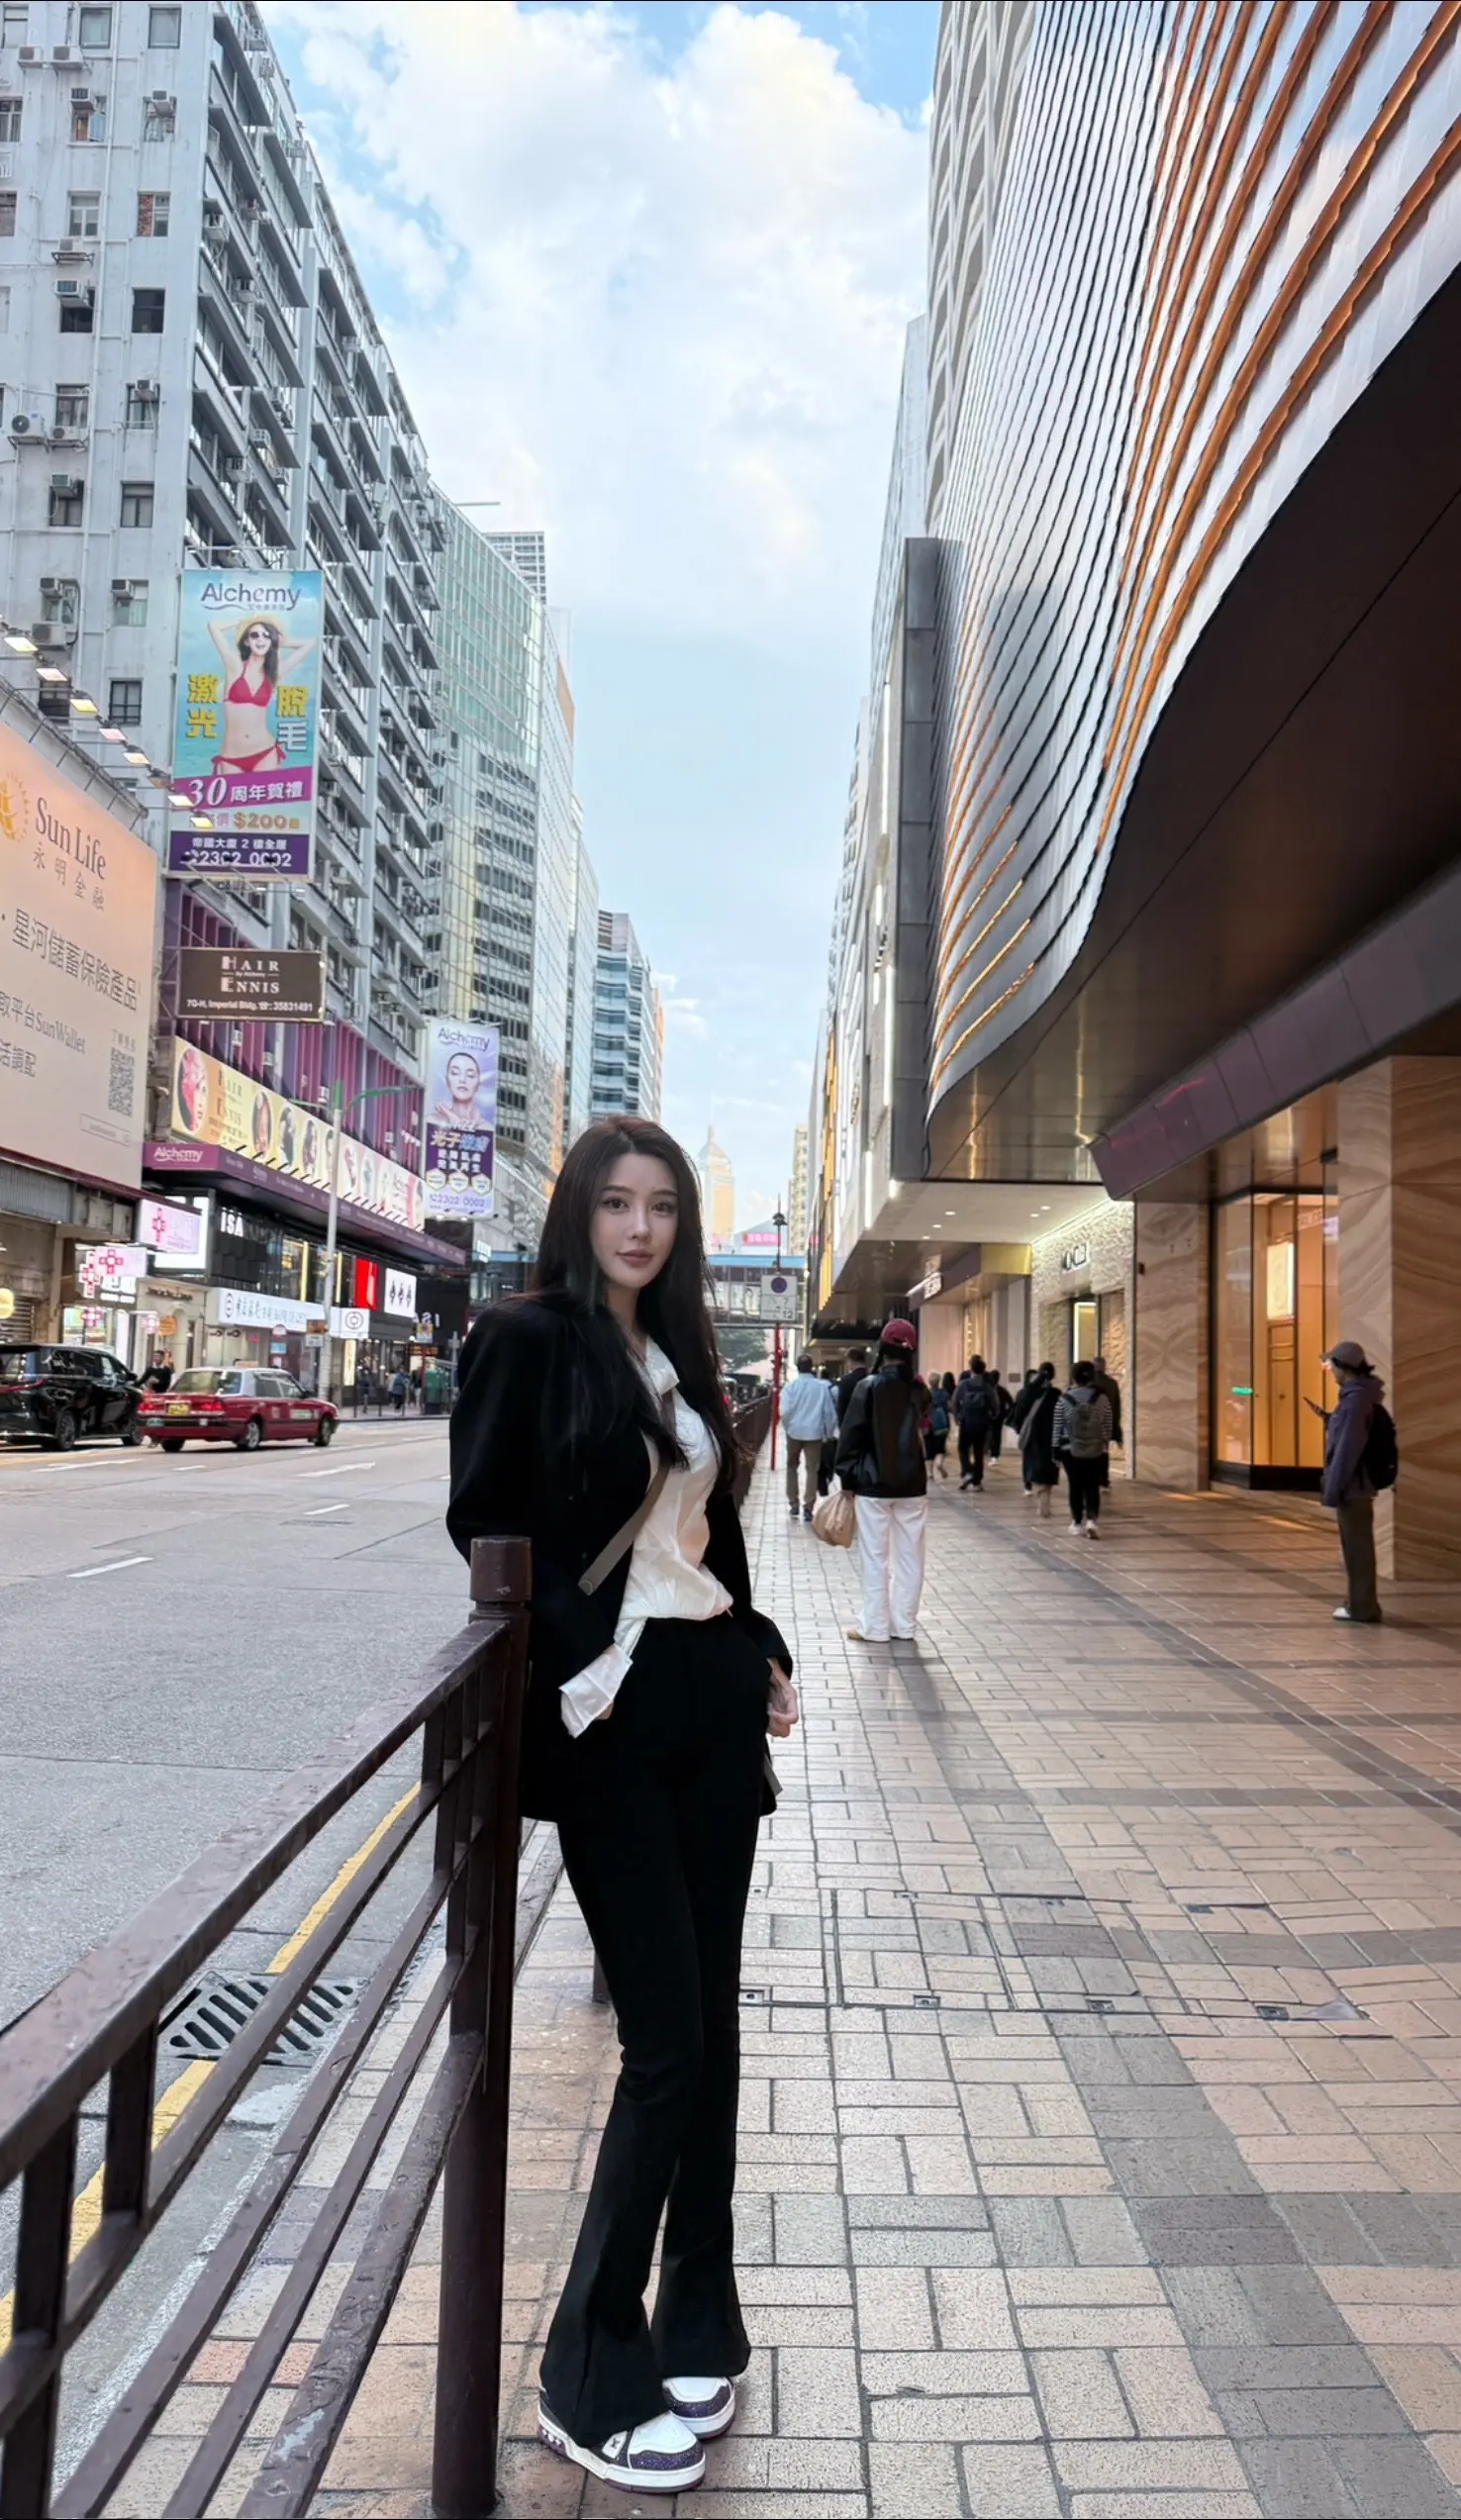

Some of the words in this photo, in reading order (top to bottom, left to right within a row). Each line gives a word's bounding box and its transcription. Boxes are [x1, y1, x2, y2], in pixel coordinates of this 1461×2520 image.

[201, 582, 302, 611] Alchemy
[189, 777, 228, 807] 30
[231, 781, 304, 803] 周年賀禮
[36, 797, 71, 855] Sun
[74, 825, 107, 880] Life
[222, 955, 280, 972] HAIR
[221, 976, 280, 994] ENNIS
[438, 1024, 490, 1052] Alchemy
[153, 1145, 204, 1163] Alchemy
